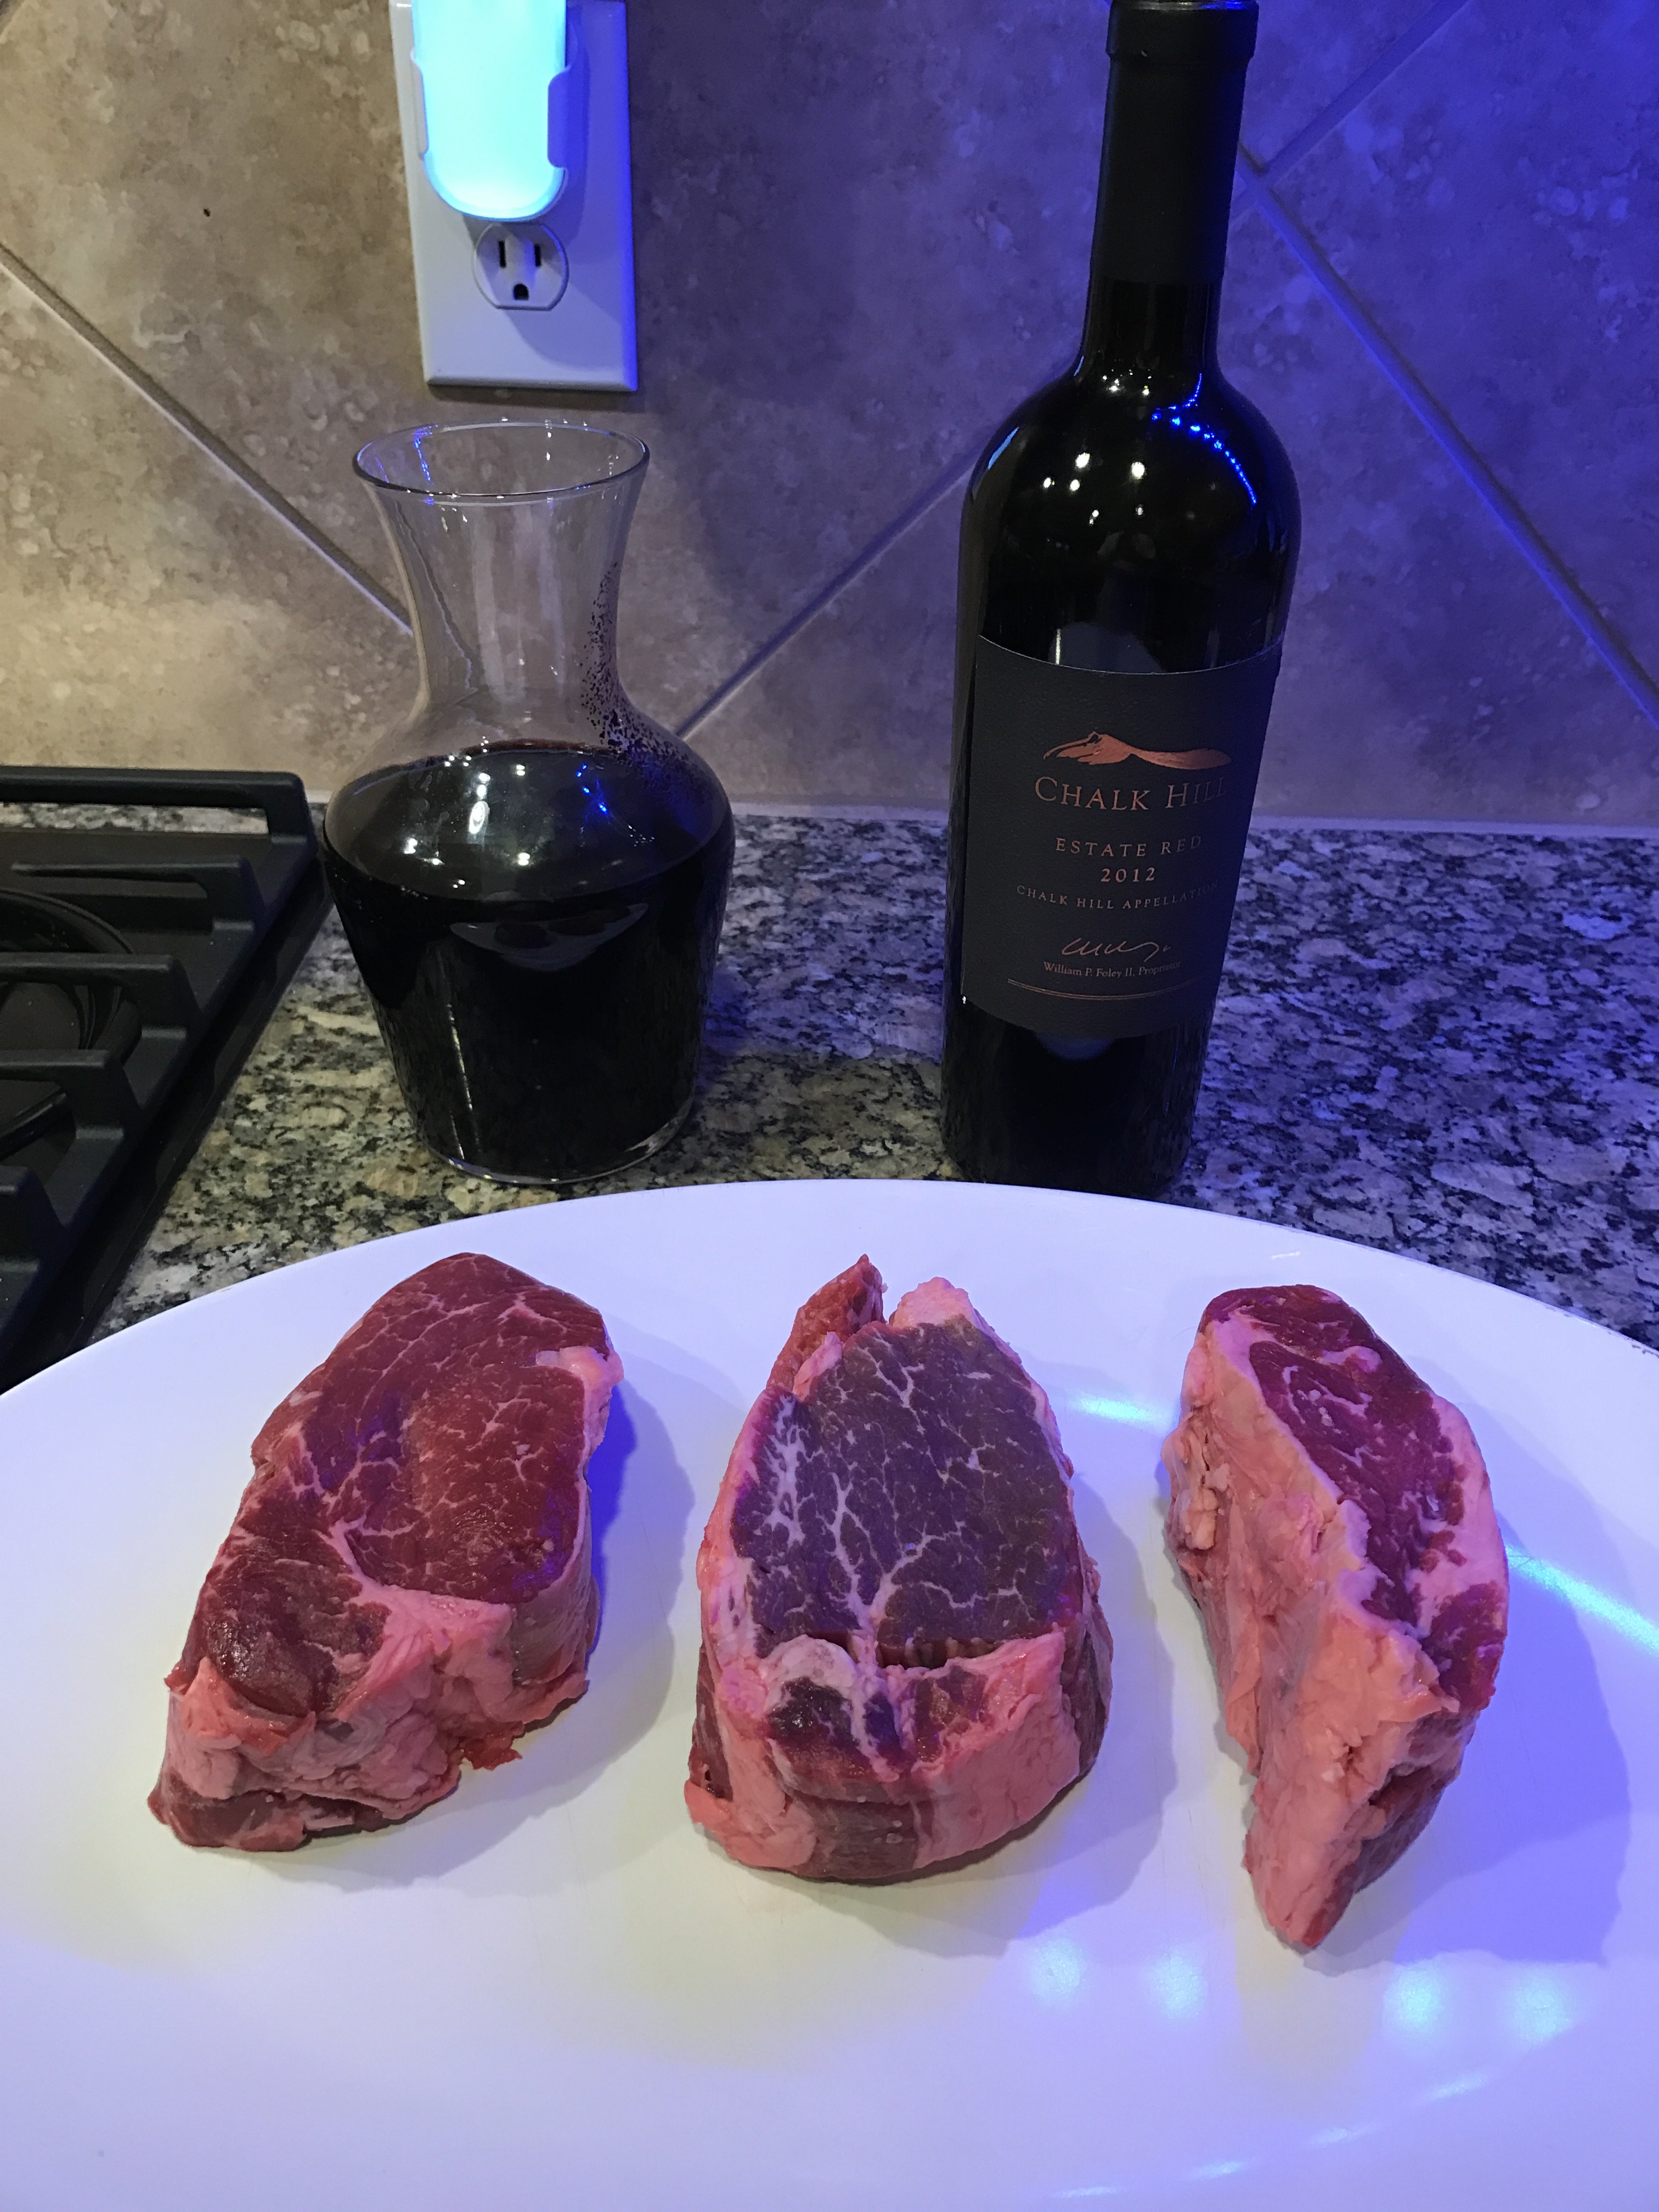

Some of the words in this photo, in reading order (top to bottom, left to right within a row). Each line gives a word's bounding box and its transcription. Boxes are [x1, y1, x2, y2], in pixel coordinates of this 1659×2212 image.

[1035, 777, 1150, 810] CHALK
[1165, 777, 1226, 808] HILL
[1056, 838, 1147, 857] ESTATE
[1160, 836, 1201, 855] RED
[1101, 867, 1155, 882] 2012
[1017, 885, 1067, 905] CHALK
[1077, 898, 1114, 909] HILL
[1122, 881, 1218, 909] APPELLATION
[1043, 961, 1082, 976] William
[1086, 968, 1093, 977] P.
[1096, 967, 1122, 978] Foley
[1138, 960, 1182, 975] Proprietor
